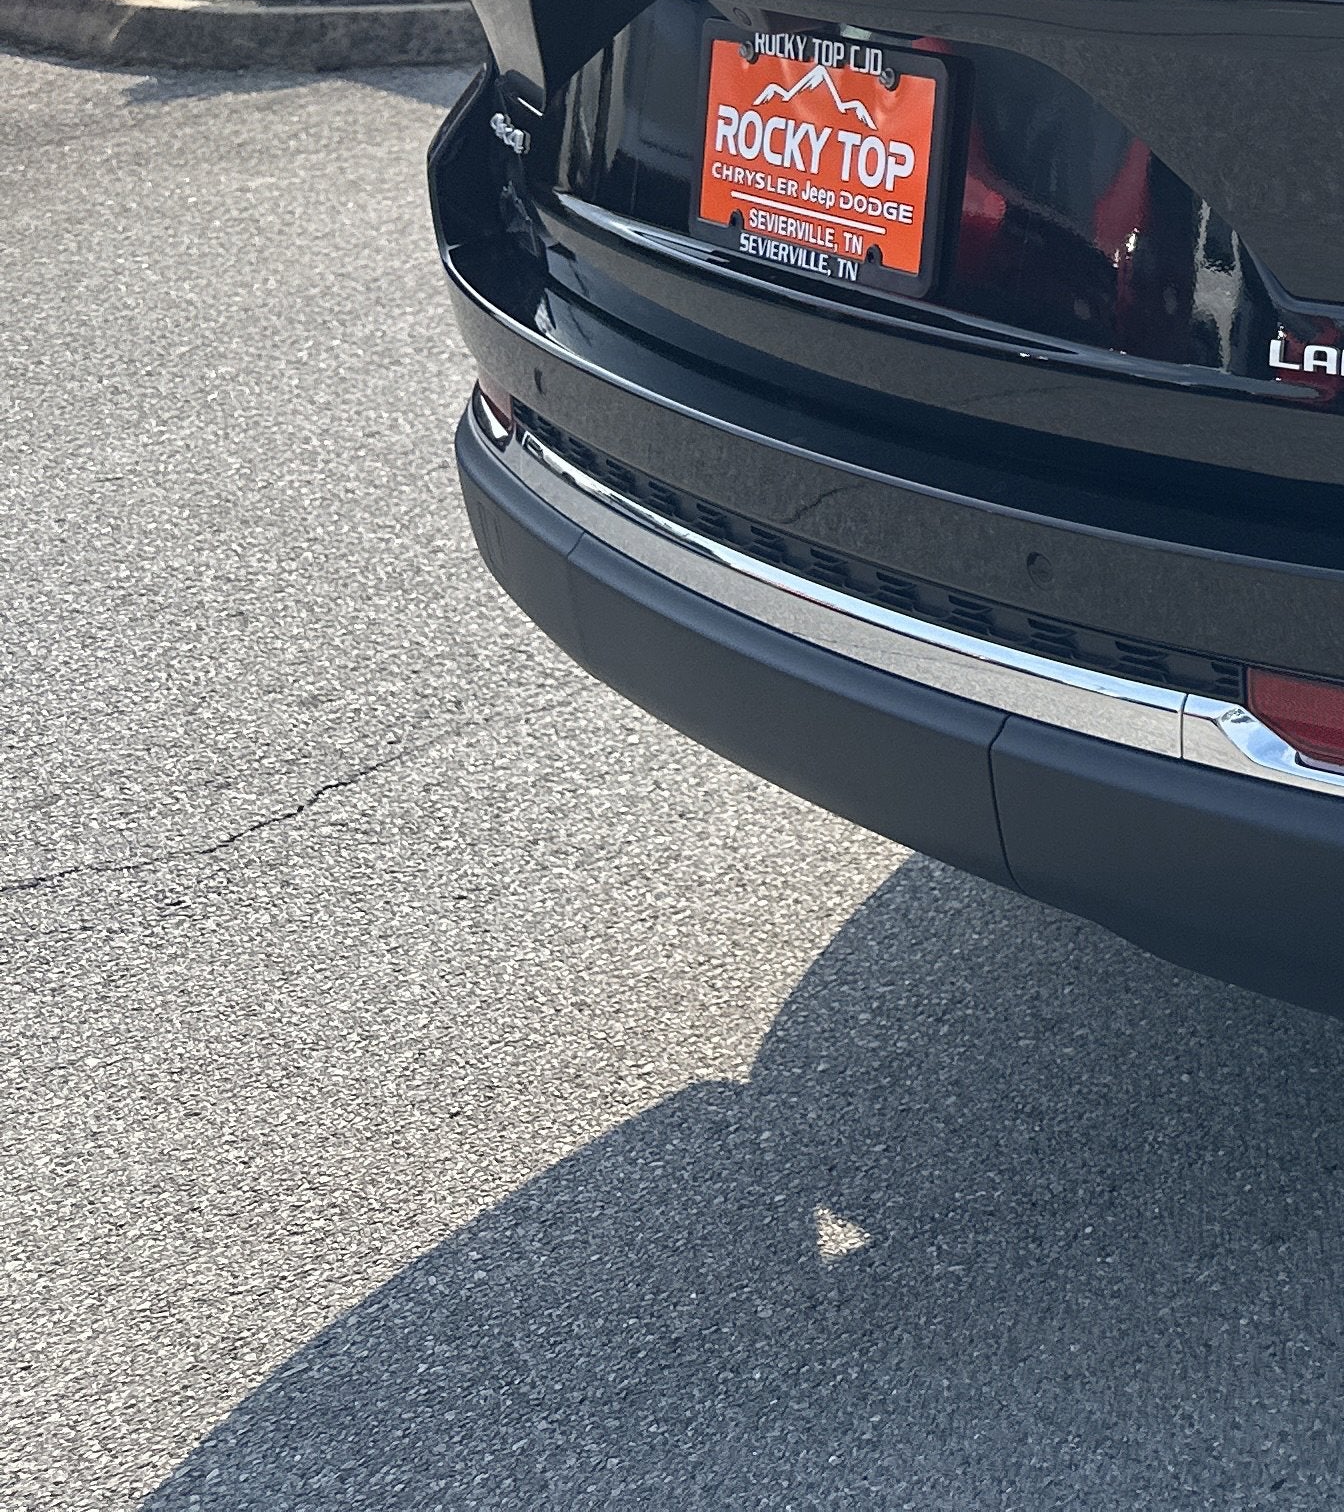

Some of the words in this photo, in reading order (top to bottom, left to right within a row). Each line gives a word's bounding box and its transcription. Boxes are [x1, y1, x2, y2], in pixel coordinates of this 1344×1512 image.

[754, 32, 806, 61] ROCKY
[812, 40, 845, 68] TOP
[850, 48, 883, 77] CJD
[713, 104, 833, 175] ROCKY
[837, 129, 915, 192] TOP
[711, 160, 798, 198] CHRYSLER
[801, 179, 836, 208] Jeep
[839, 191, 914, 225] DODGE
[748, 208, 838, 252] SEVIERVILLE,
[843, 232, 864, 255] TN
[739, 232, 832, 278] SEVIERVILLE,
[837, 256, 859, 282] TN
